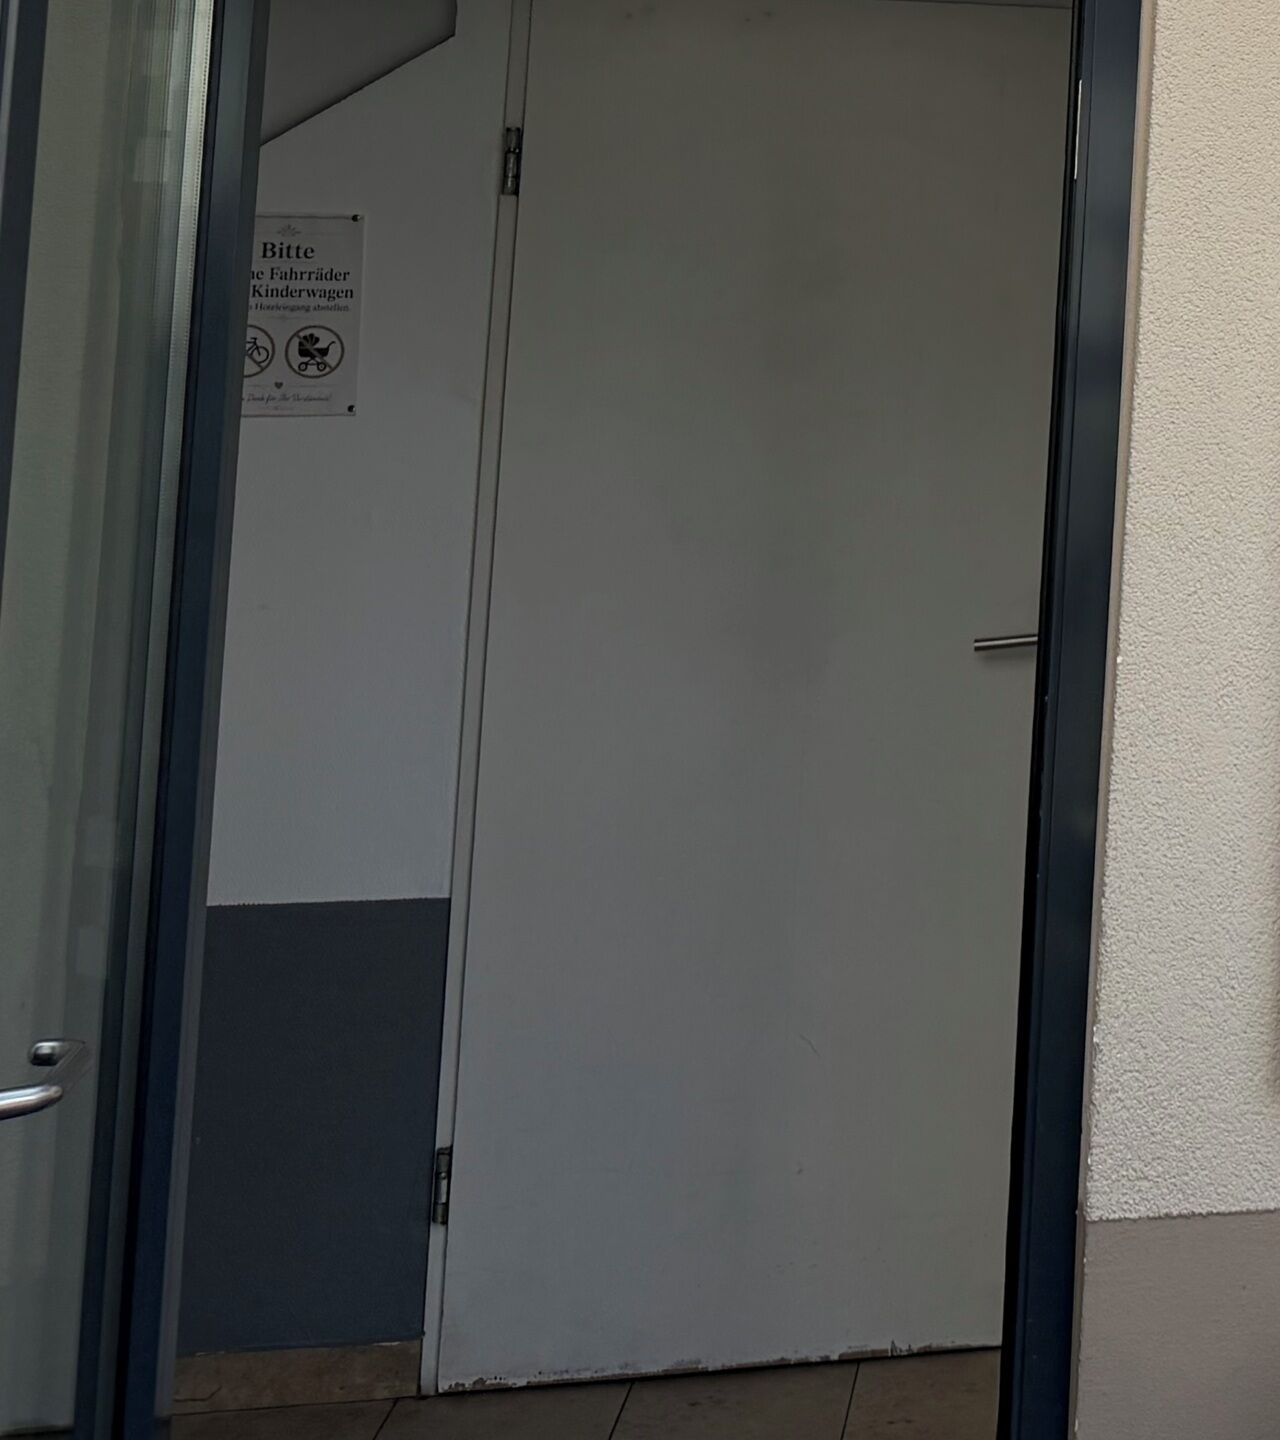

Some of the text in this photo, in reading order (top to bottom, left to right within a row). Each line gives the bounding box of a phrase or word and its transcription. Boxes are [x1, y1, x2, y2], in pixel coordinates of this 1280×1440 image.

[262, 241, 315, 259] Bitte
[270, 266, 350, 281] Fahrräder
[252, 284, 354, 302] Kinderwagen
